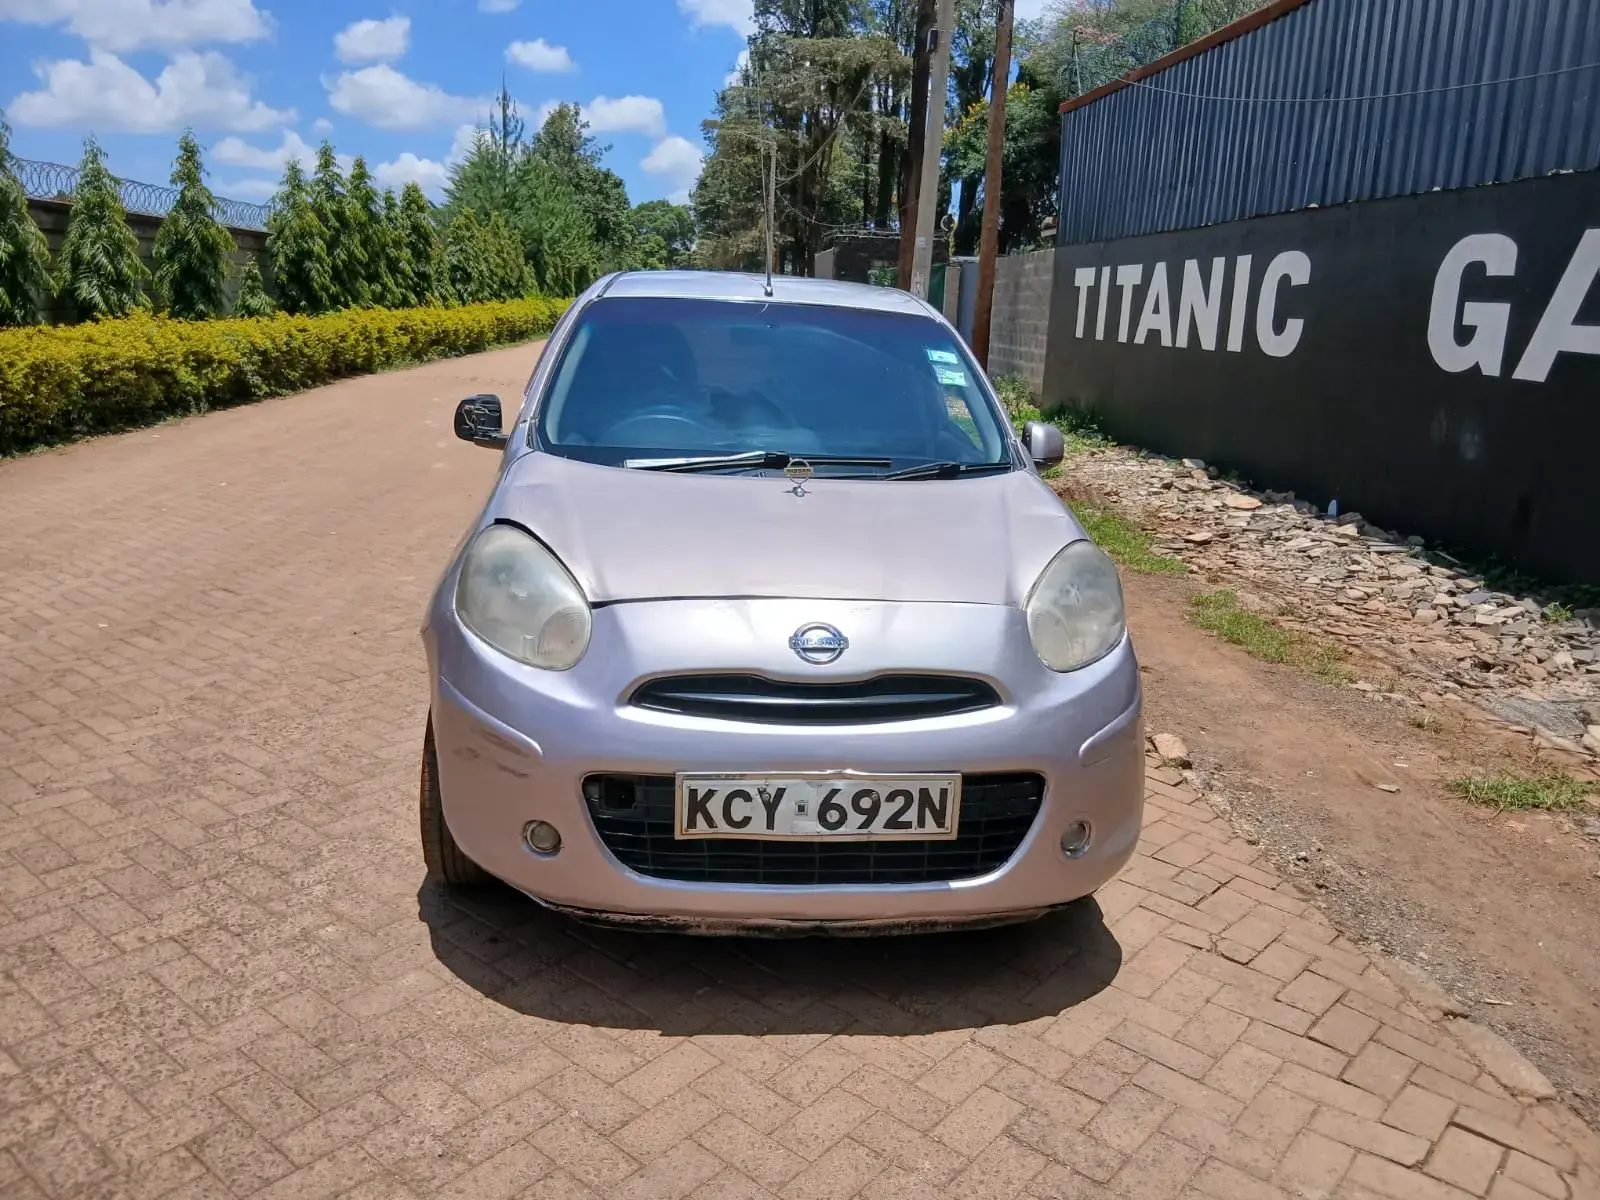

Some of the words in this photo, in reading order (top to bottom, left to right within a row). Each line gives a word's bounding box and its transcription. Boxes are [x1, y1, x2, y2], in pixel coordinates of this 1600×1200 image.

[1074, 250, 1311, 358] TITANIC
[1427, 227, 1600, 383] GA
[686, 787, 787, 830] KCY
[817, 787, 949, 831] 692N
